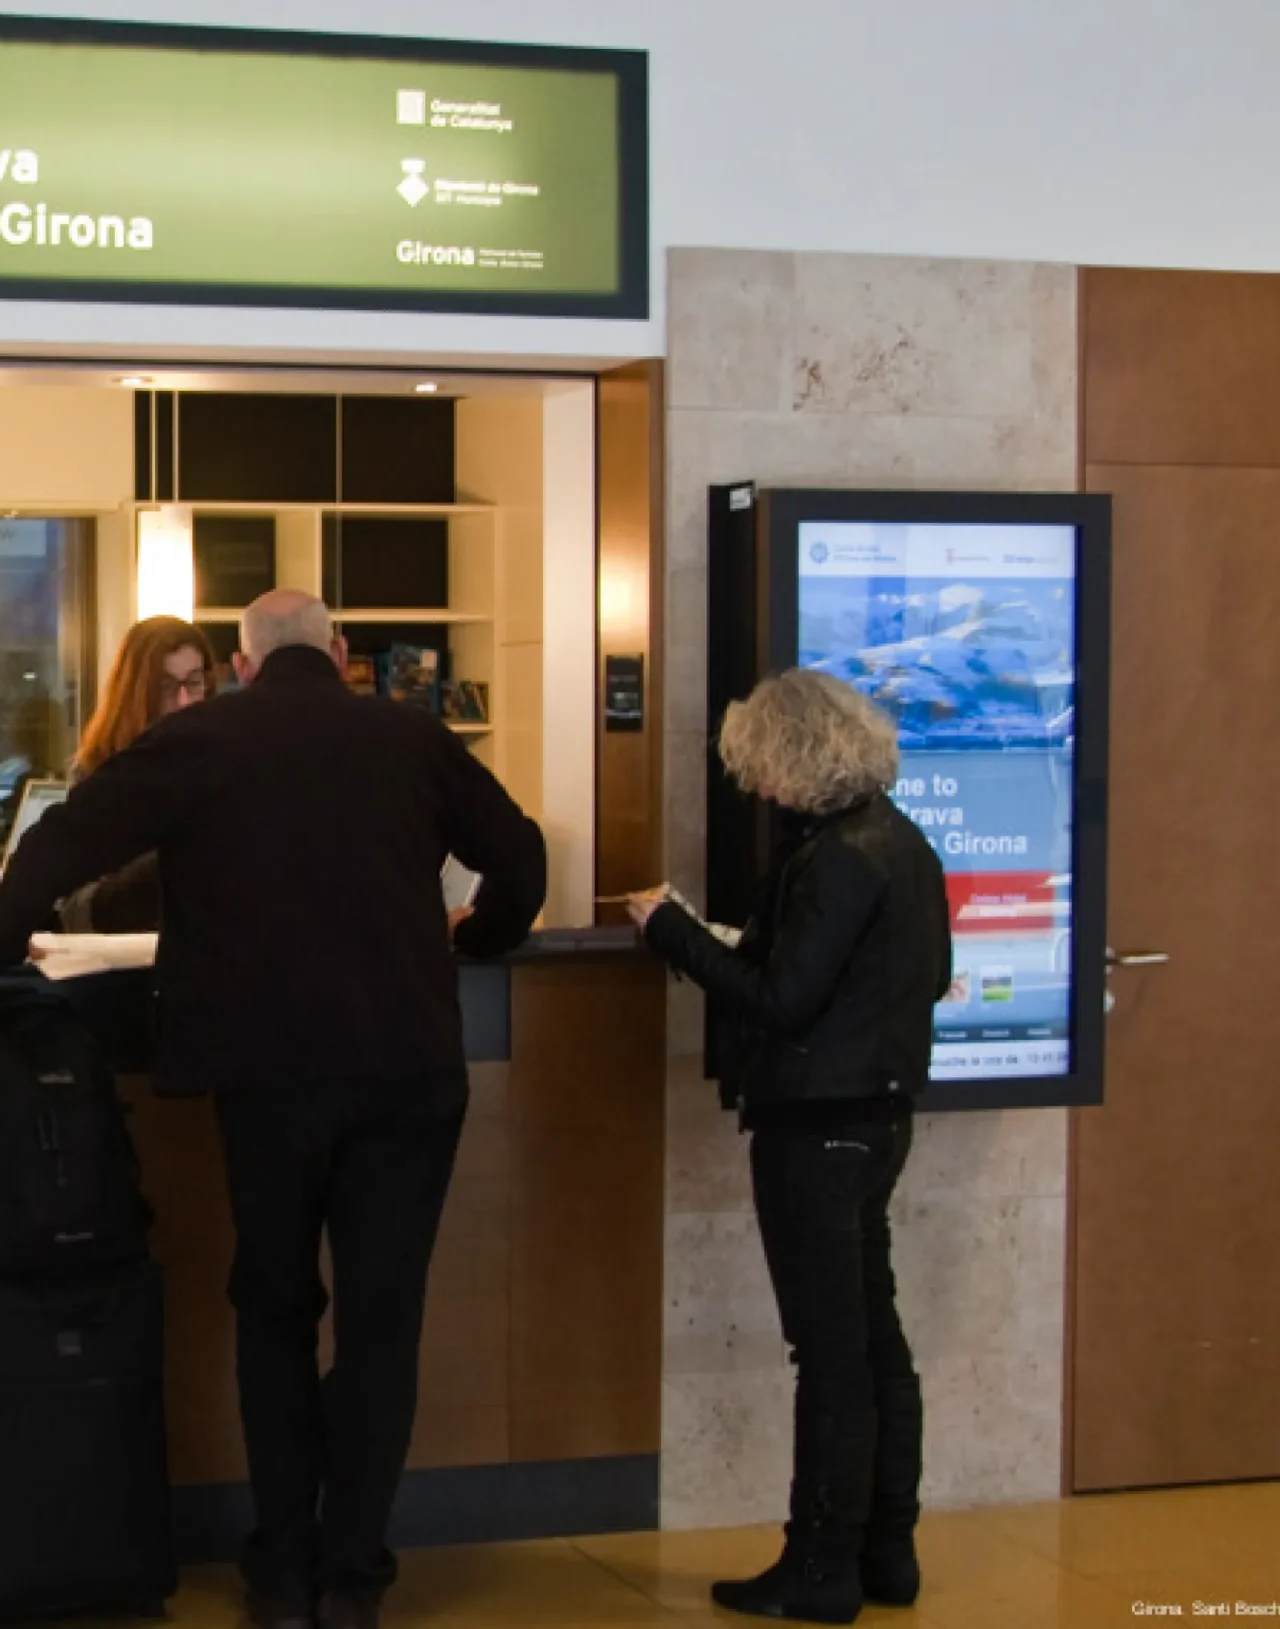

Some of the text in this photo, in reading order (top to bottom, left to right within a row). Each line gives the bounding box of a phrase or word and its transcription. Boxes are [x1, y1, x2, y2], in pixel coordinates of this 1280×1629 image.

[0, 202, 154, 250] Girona
[932, 773, 959, 797] to
[944, 830, 1028, 855] Girona
